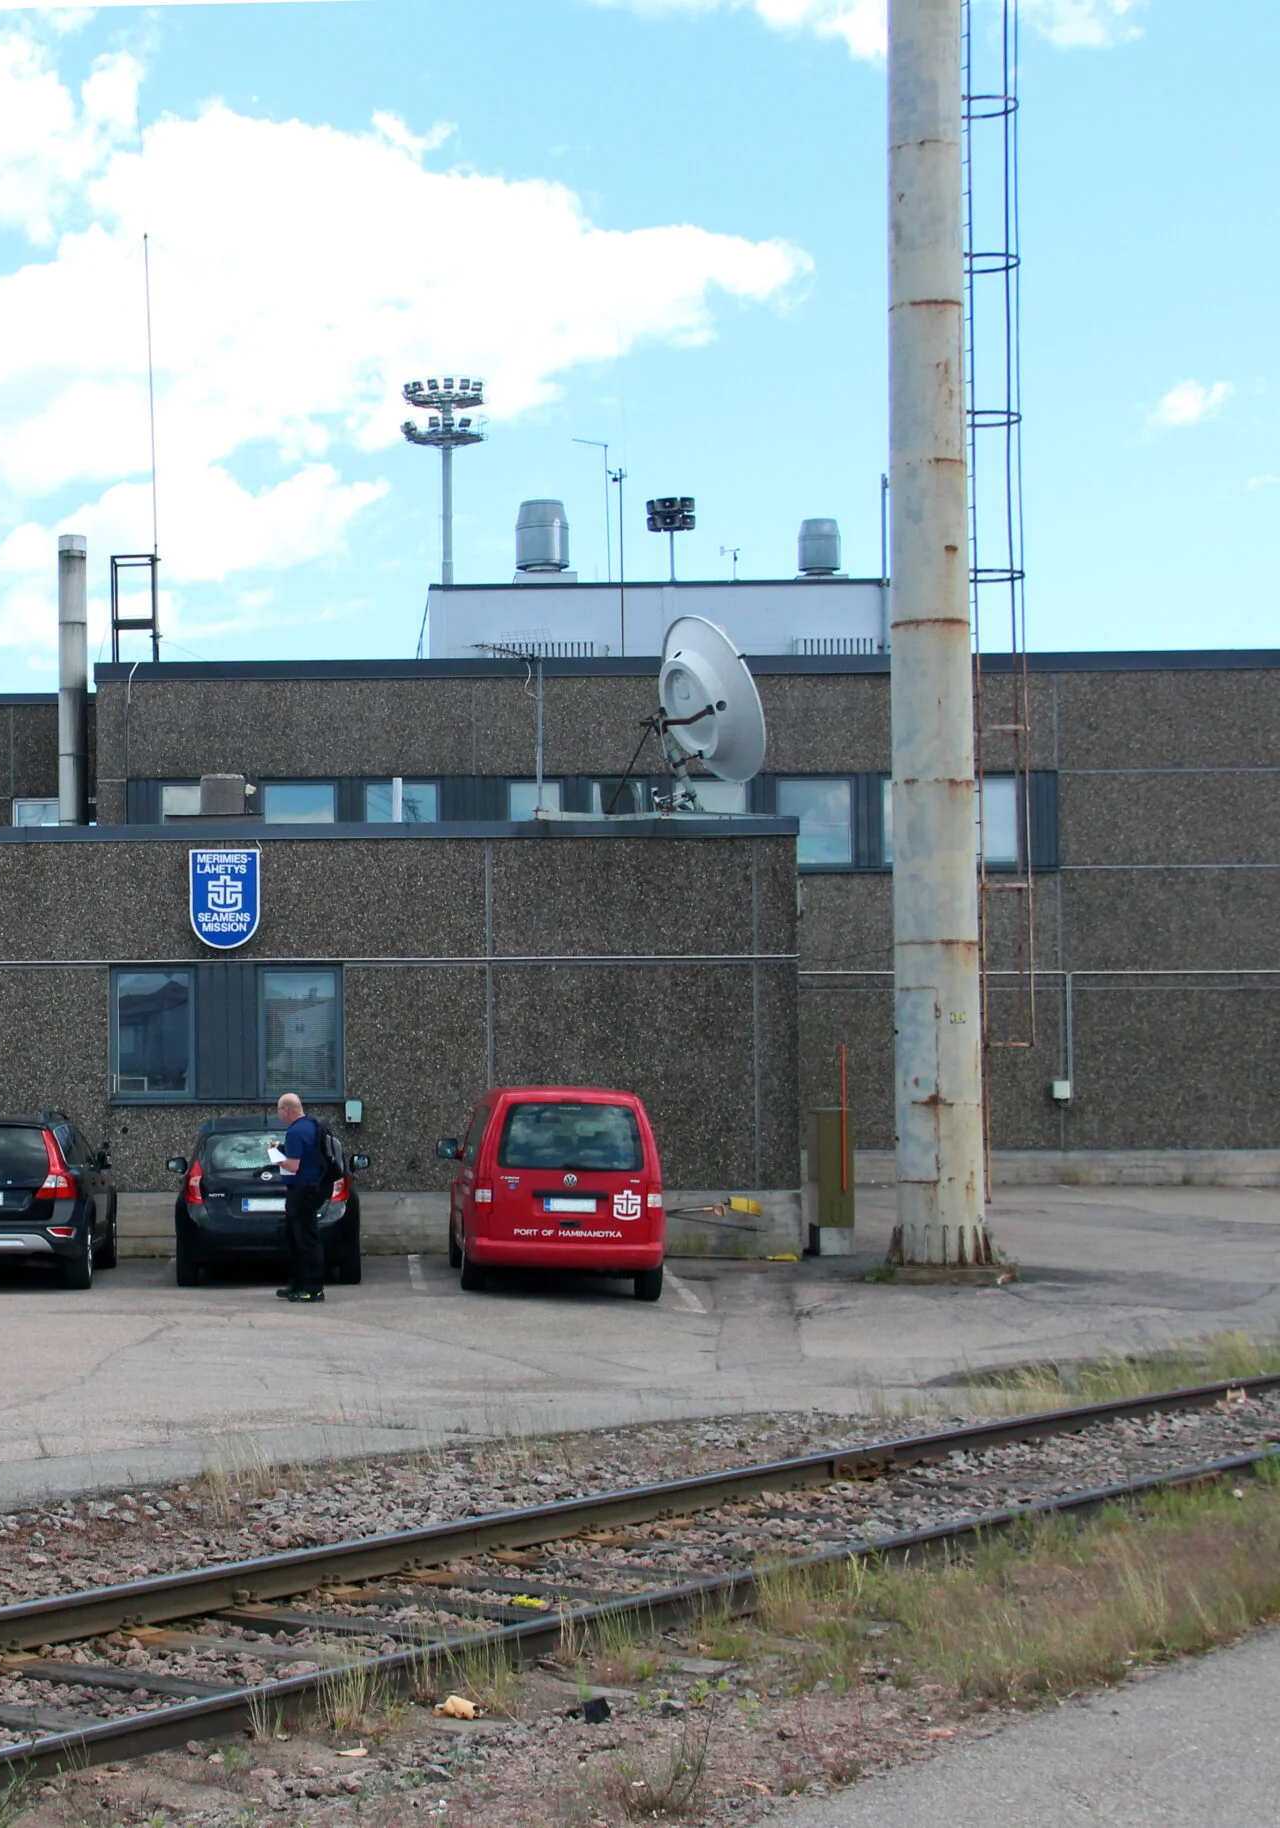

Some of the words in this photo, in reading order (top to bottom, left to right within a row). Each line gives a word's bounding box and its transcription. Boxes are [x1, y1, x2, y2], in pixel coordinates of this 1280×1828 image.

[197, 854, 252, 864] MERIMIES-
[197, 863, 247, 874] LÄHETYS
[198, 913, 251, 922] SEAMENS
[202, 923, 247, 932] MISSION
[513, 1228, 538, 1237] PORT
[542, 1229, 554, 1237] OF
[558, 1230, 622, 1238] HAMINAKOTKA
